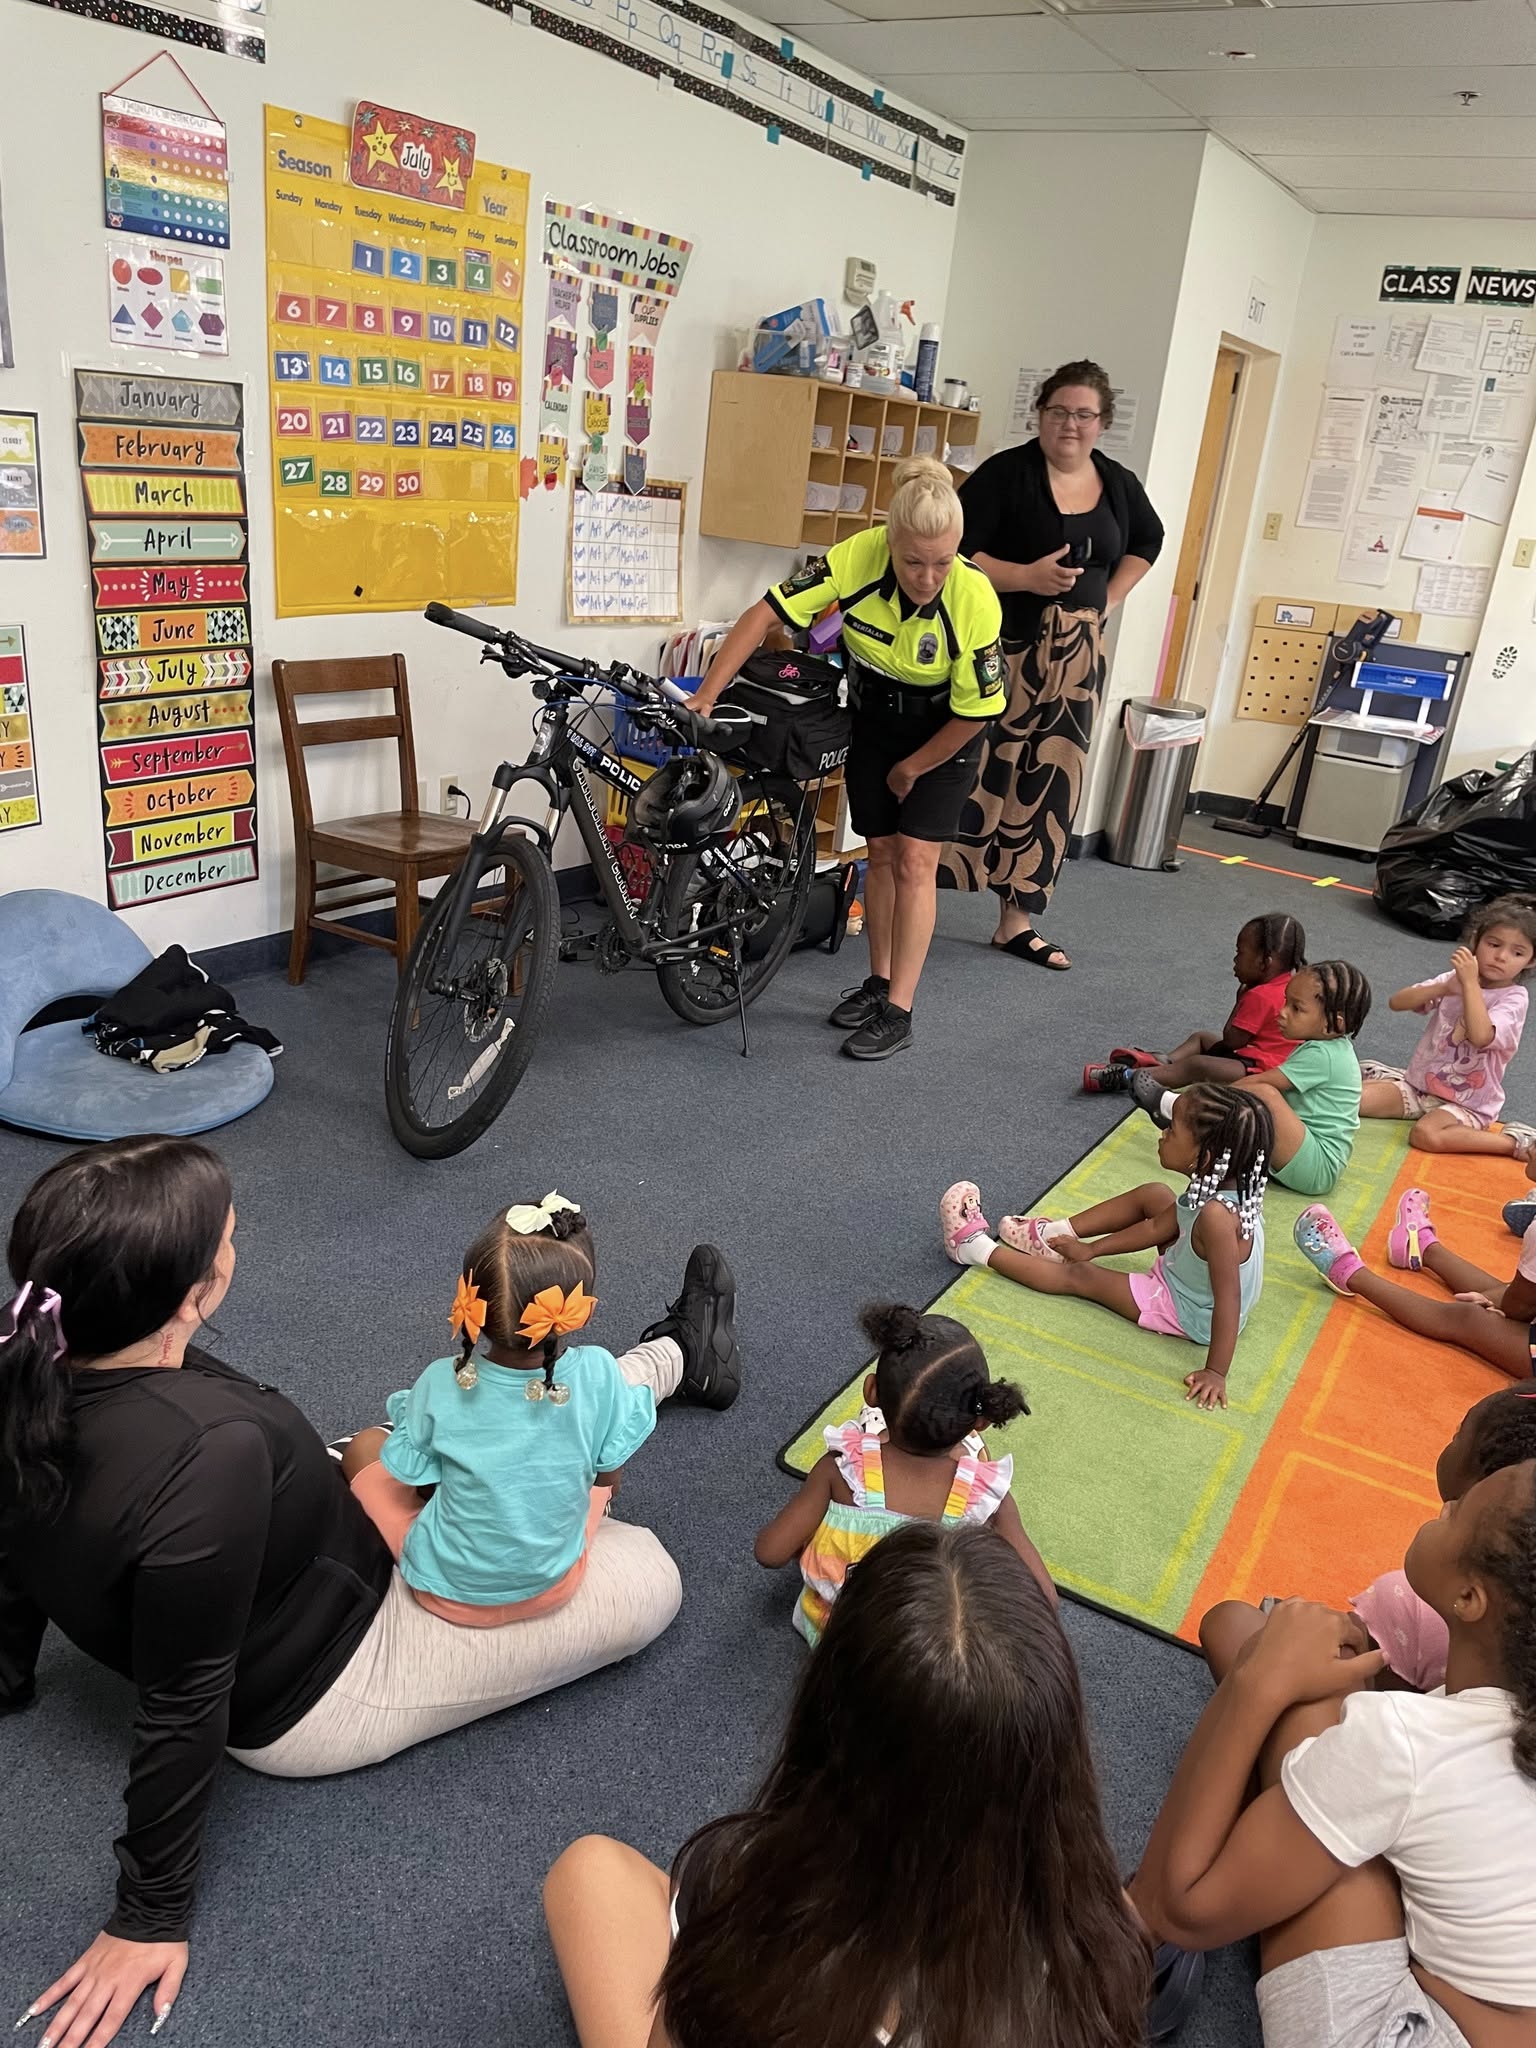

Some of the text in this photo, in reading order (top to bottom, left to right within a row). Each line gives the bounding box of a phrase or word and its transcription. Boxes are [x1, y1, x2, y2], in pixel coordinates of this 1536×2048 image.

[659, 14, 684, 65] Qq
[701, 32, 722, 65] Rr
[741, 54, 756, 86] Ss
[778, 70, 792, 103] Tt
[278, 150, 332, 178] Season
[402, 146, 431, 177] July
[276, 189, 518, 249] Sunday Monday Tuesday Wednesday Thursday Friday Saturday
[483, 196, 508, 216] Year
[150, 250, 183, 266] Shapes
[550, 222, 680, 279] Classroom Jobs
[365, 251, 512, 287] 1 2 3 4 5
[1384, 274, 1536, 298] CLASS NEWS
[287, 302, 515, 344] 6 7 8 9 10 11 12
[634, 314, 659, 326] SUPPLIES
[281, 358, 512, 397] 13 14 15 16 17 18 19
[120, 381, 202, 418] January
[544, 400, 568, 413] CALENDAR
[280, 413, 513, 445] 20 21 22 23 24 25 26
[116, 430, 206, 465] February
[544, 455, 561, 465] PAPERS
[284, 462, 419, 492] 27 28 29 30
[136, 481, 194, 506] March
[144, 527, 192, 555] April
[153, 572, 191, 599] May
[152, 619, 195, 643] June
[157, 660, 198, 686] July
[148, 700, 211, 728] August
[132, 740, 225, 773] September
[819, 746, 849, 771] POLICE
[600, 756, 642, 792] POLIC
[147, 782, 217, 812] October
[140, 822, 226, 854] November
[654, 842, 689, 850] POLI
[145, 861, 227, 894] December
